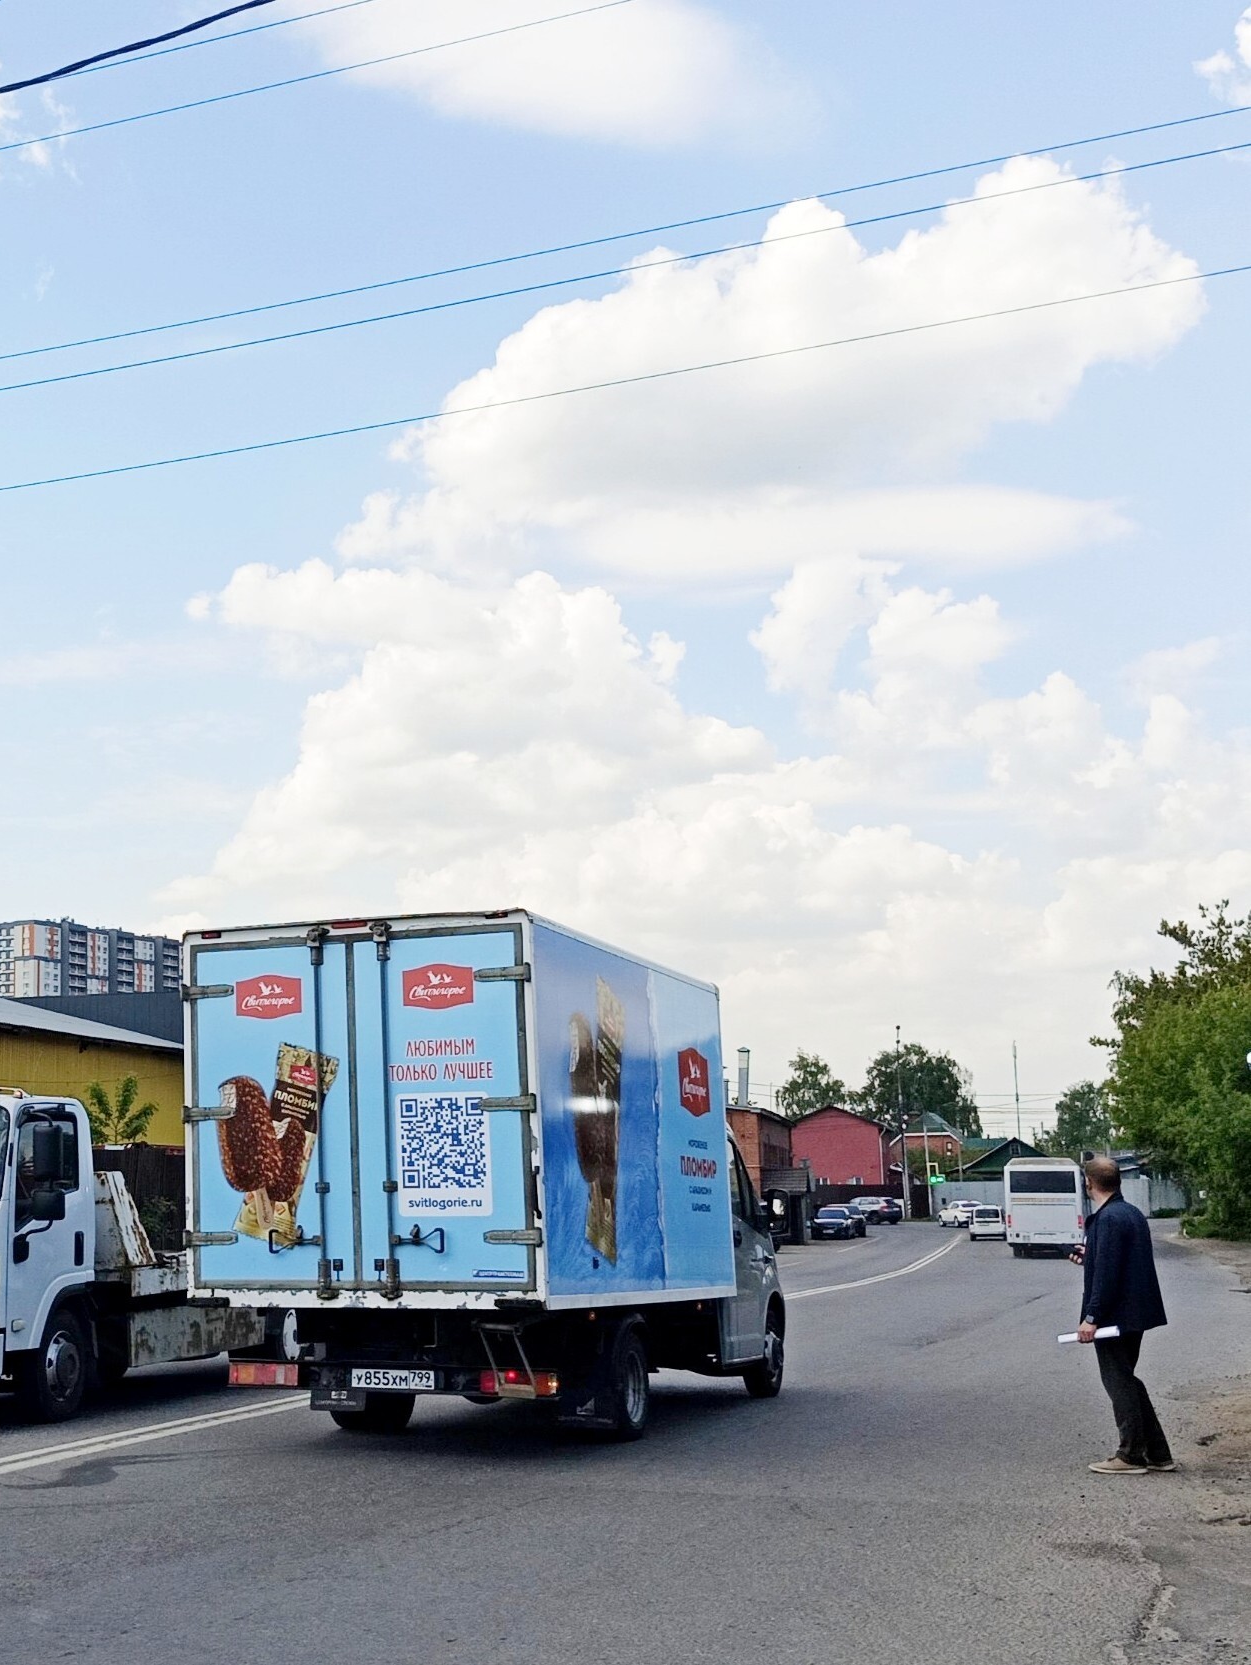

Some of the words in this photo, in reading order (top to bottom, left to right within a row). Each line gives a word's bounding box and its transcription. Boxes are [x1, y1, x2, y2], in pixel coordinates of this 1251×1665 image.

[406, 1038, 475, 1057] ЛЮБИМЫМ
[389, 1063, 438, 1082] ТОЛЬКО
[443, 1062, 493, 1082] ЛУЧШЕЕ
[680, 1155, 717, 1179] ПЛОМБИР
[408, 1197, 483, 1211] svitlogorie.ru
[355, 1371, 409, 1387] У855ХМ
[410, 1371, 431, 1383] 799
